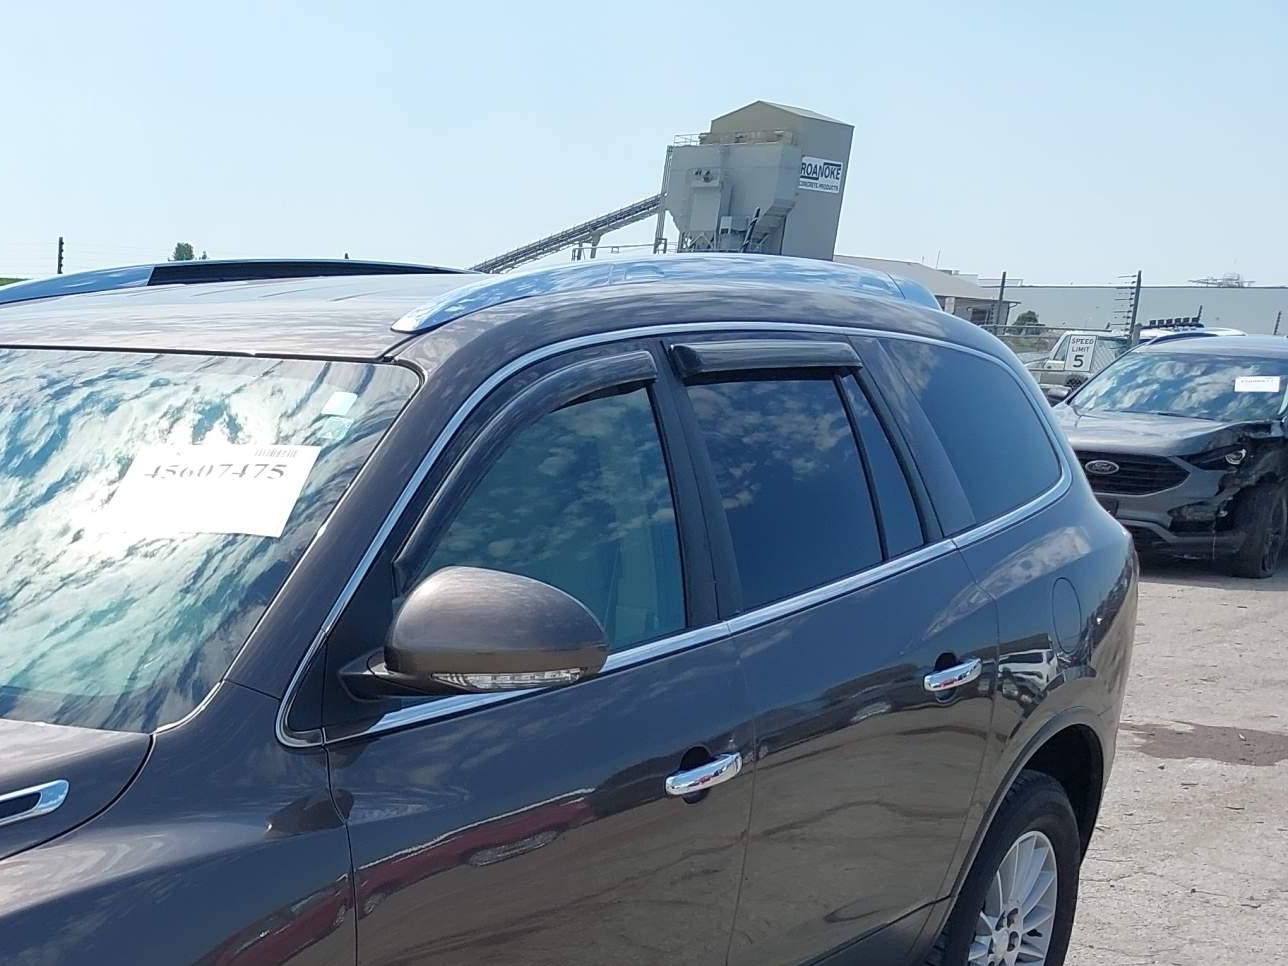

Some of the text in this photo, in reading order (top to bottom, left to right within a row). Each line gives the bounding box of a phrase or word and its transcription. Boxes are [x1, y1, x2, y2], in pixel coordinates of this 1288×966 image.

[800, 162, 842, 180] ROANOKE
[1072, 337, 1094, 345] SPEED
[1073, 354, 1084, 367] 5
[144, 464, 288, 480] 45607475
